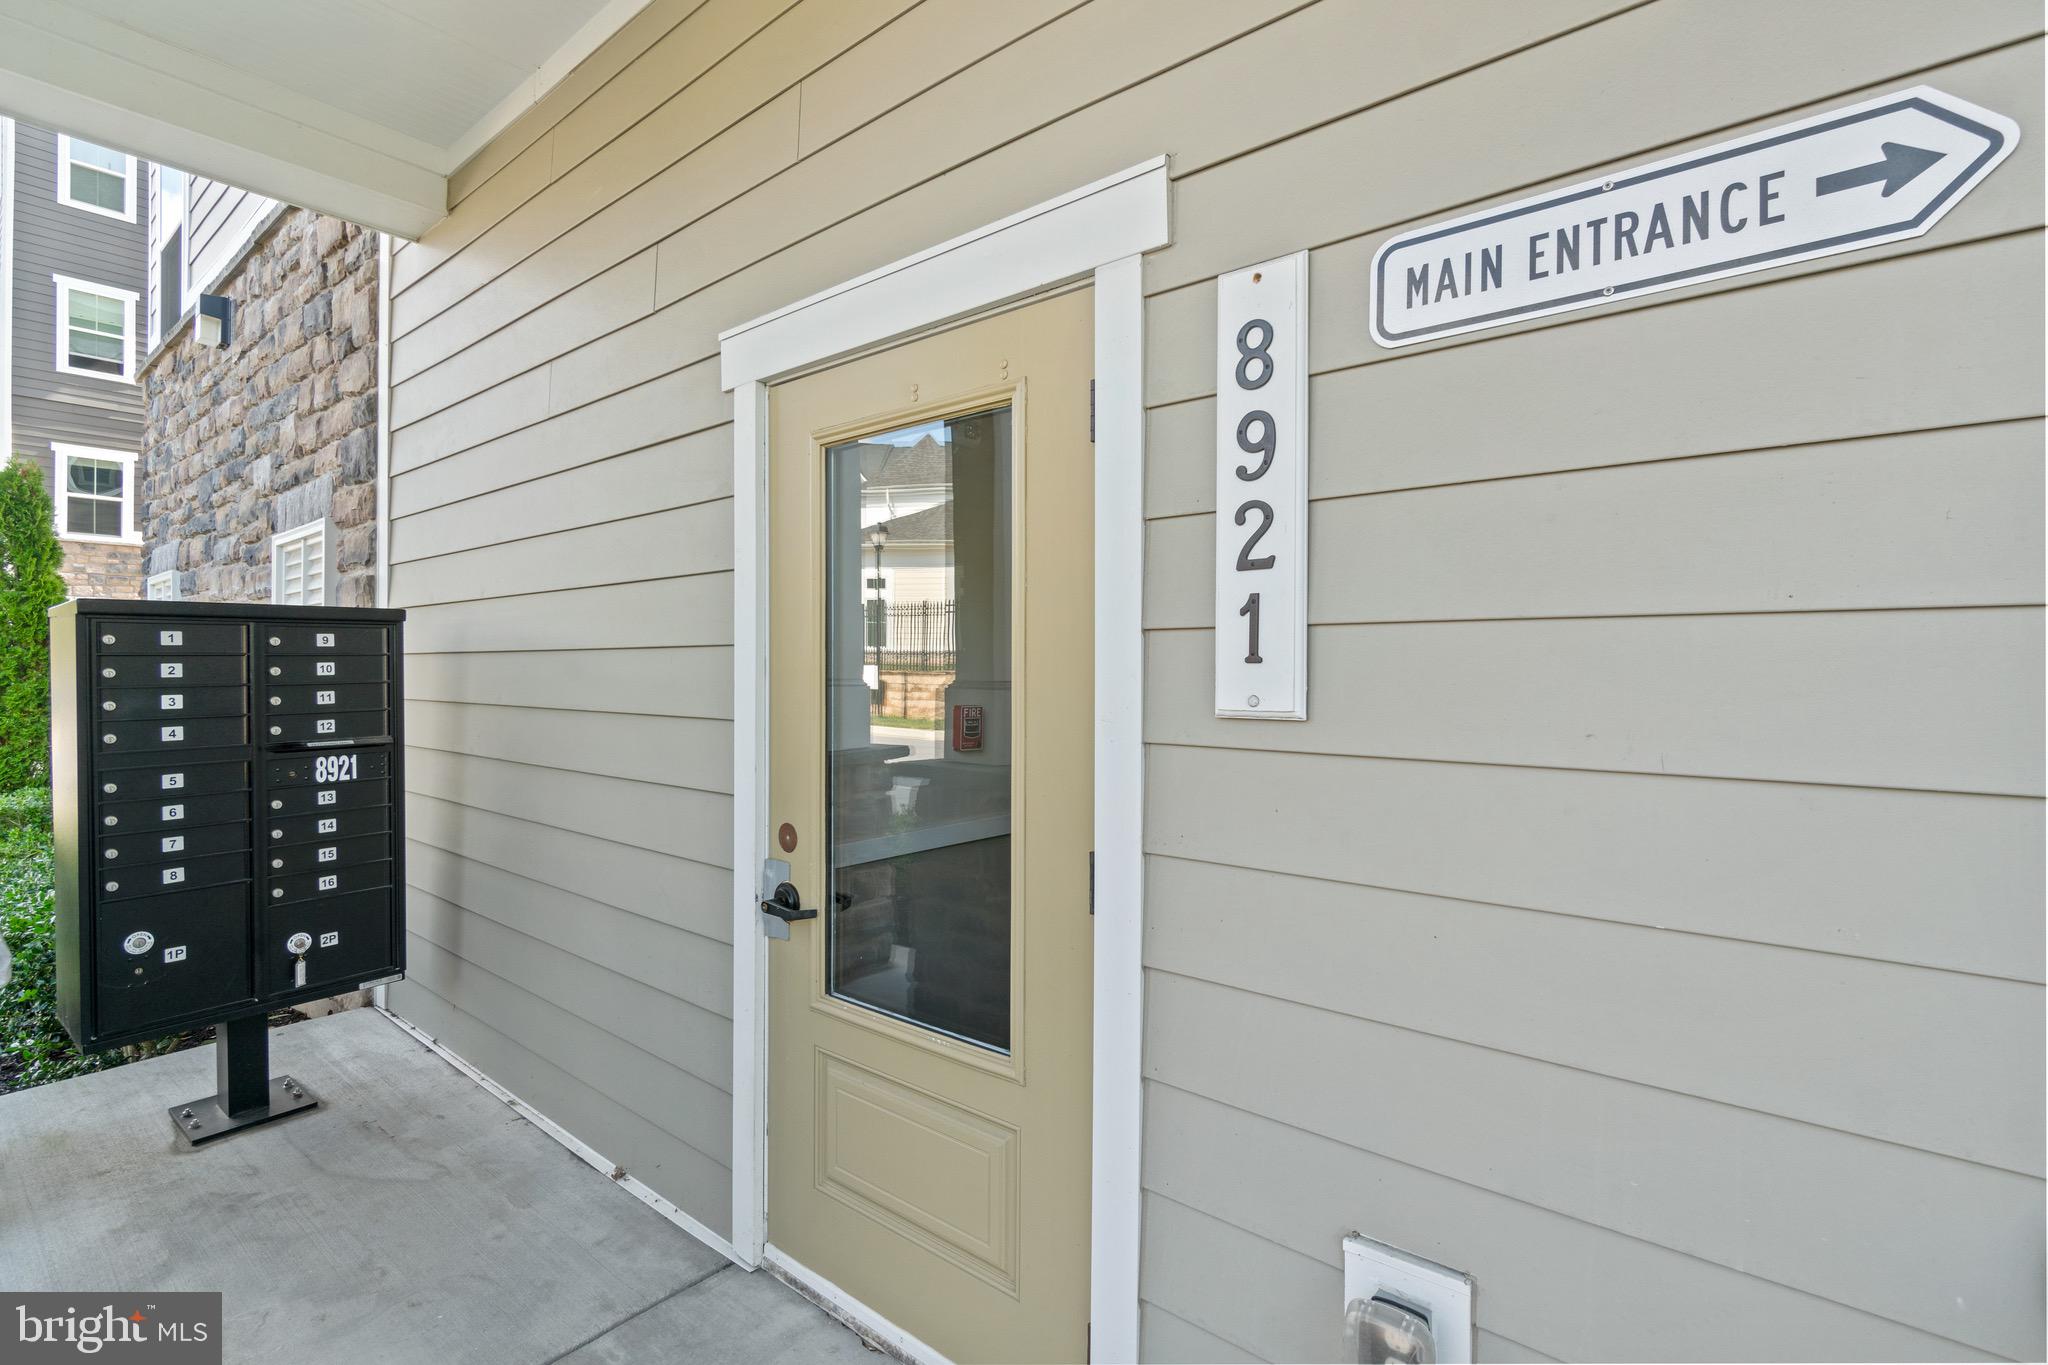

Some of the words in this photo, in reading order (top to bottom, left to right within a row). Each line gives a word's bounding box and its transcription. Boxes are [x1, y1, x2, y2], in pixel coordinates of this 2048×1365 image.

[1406, 244, 1504, 309] MAIN
[1528, 169, 1787, 280] ENTRANCE
[1235, 318, 1277, 665] 8921
[168, 634, 174, 643] 1
[321, 635, 329, 645] 9
[167, 665, 176, 676] 2
[319, 664, 333, 674] 10
[168, 697, 176, 707] 3
[319, 693, 332, 702] 11
[963, 707, 982, 718] FIRE
[319, 721, 333, 731] 12
[168, 729, 176, 738] 4
[315, 754, 358, 783] 8921
[169, 776, 177, 786] 5
[320, 792, 334, 802] 13
[169, 807, 177, 817] 6
[321, 821, 335, 831] 14
[168, 839, 177, 849] 7
[321, 849, 335, 859] 15
[169, 870, 178, 880] 8
[321, 878, 335, 888] 16
[321, 934, 337, 945] 2P
[167, 948, 184, 960] 1P
